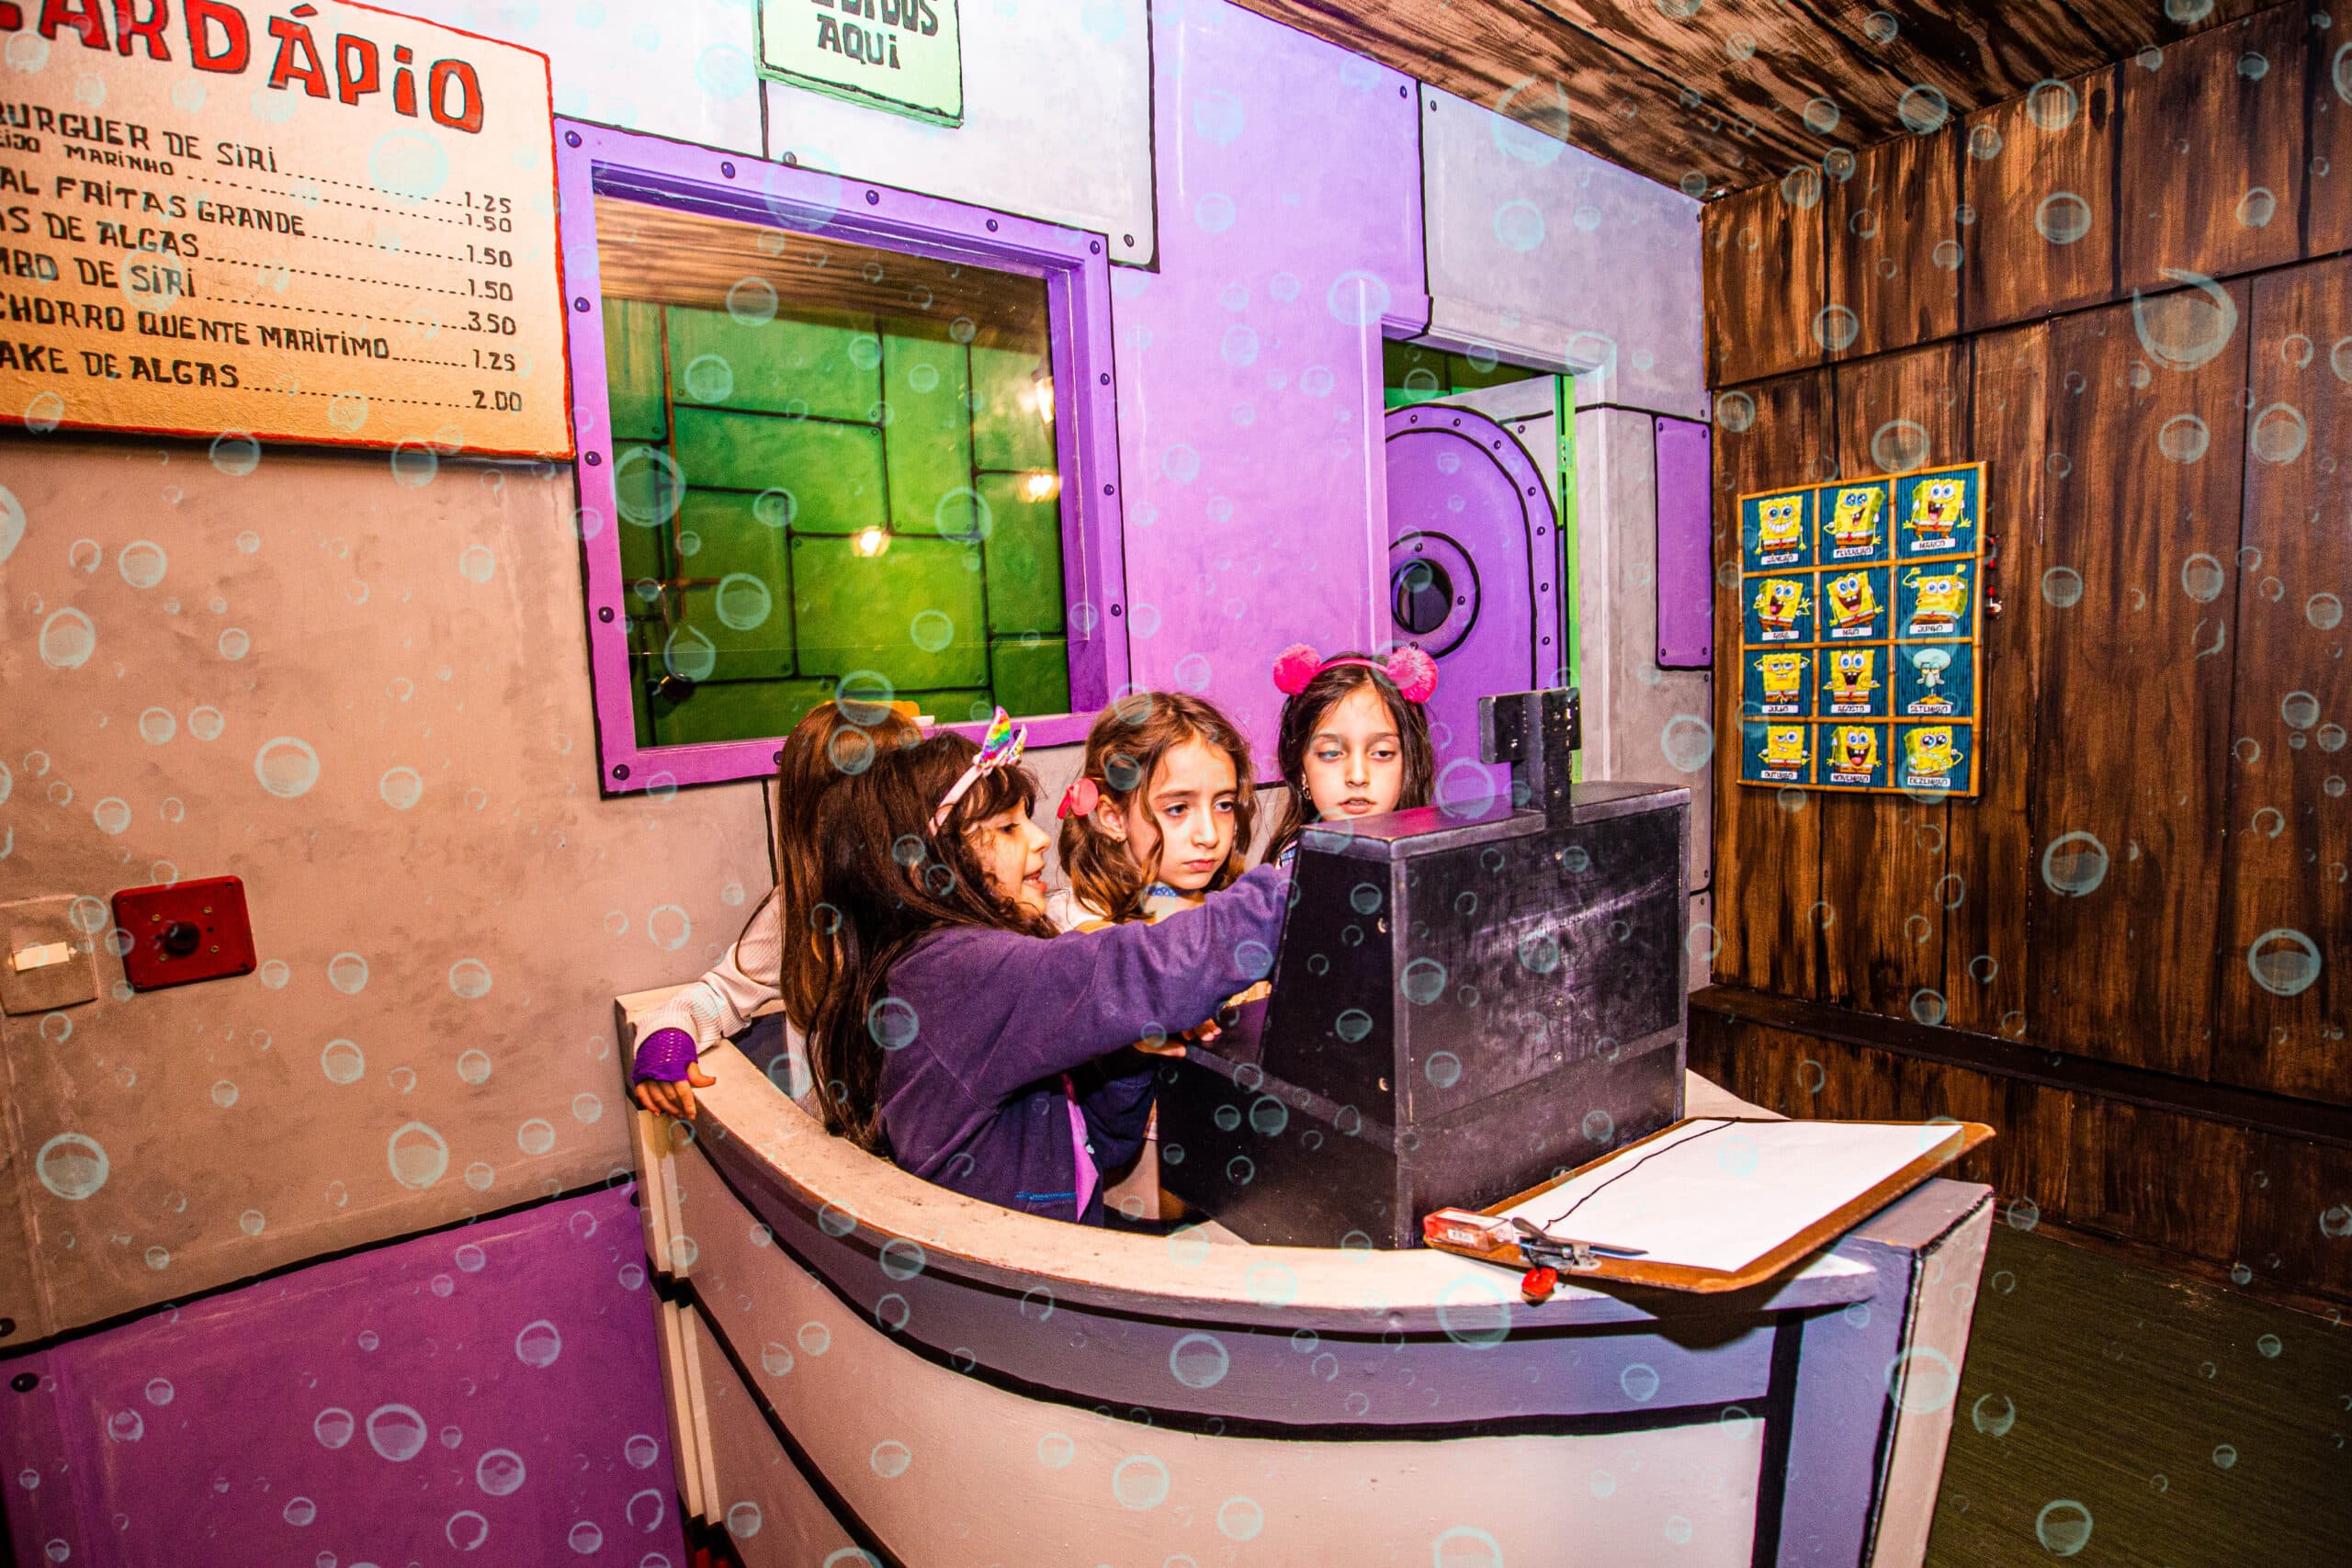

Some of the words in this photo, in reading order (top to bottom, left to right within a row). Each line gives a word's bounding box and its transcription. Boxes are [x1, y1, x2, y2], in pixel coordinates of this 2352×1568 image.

[163, 130, 202, 161] DE
[464, 190, 512, 214] 1.25
[42, 210, 86, 243] DE
[96, 220, 199, 257] ALGAS
[468, 278, 514, 302] 1.50
[198, 200, 306, 237] GRANDE
[466, 243, 513, 268] 1.50
[465, 212, 513, 233] 1.50
[74, 257, 119, 288] DE
[468, 310, 517, 336] 3.50
[138, 310, 251, 345] QUENTE
[472, 348, 516, 372] 1.25
[80, 351, 122, 379] DE
[129, 355, 240, 389] ALGAS
[471, 389, 523, 412] 2.00
